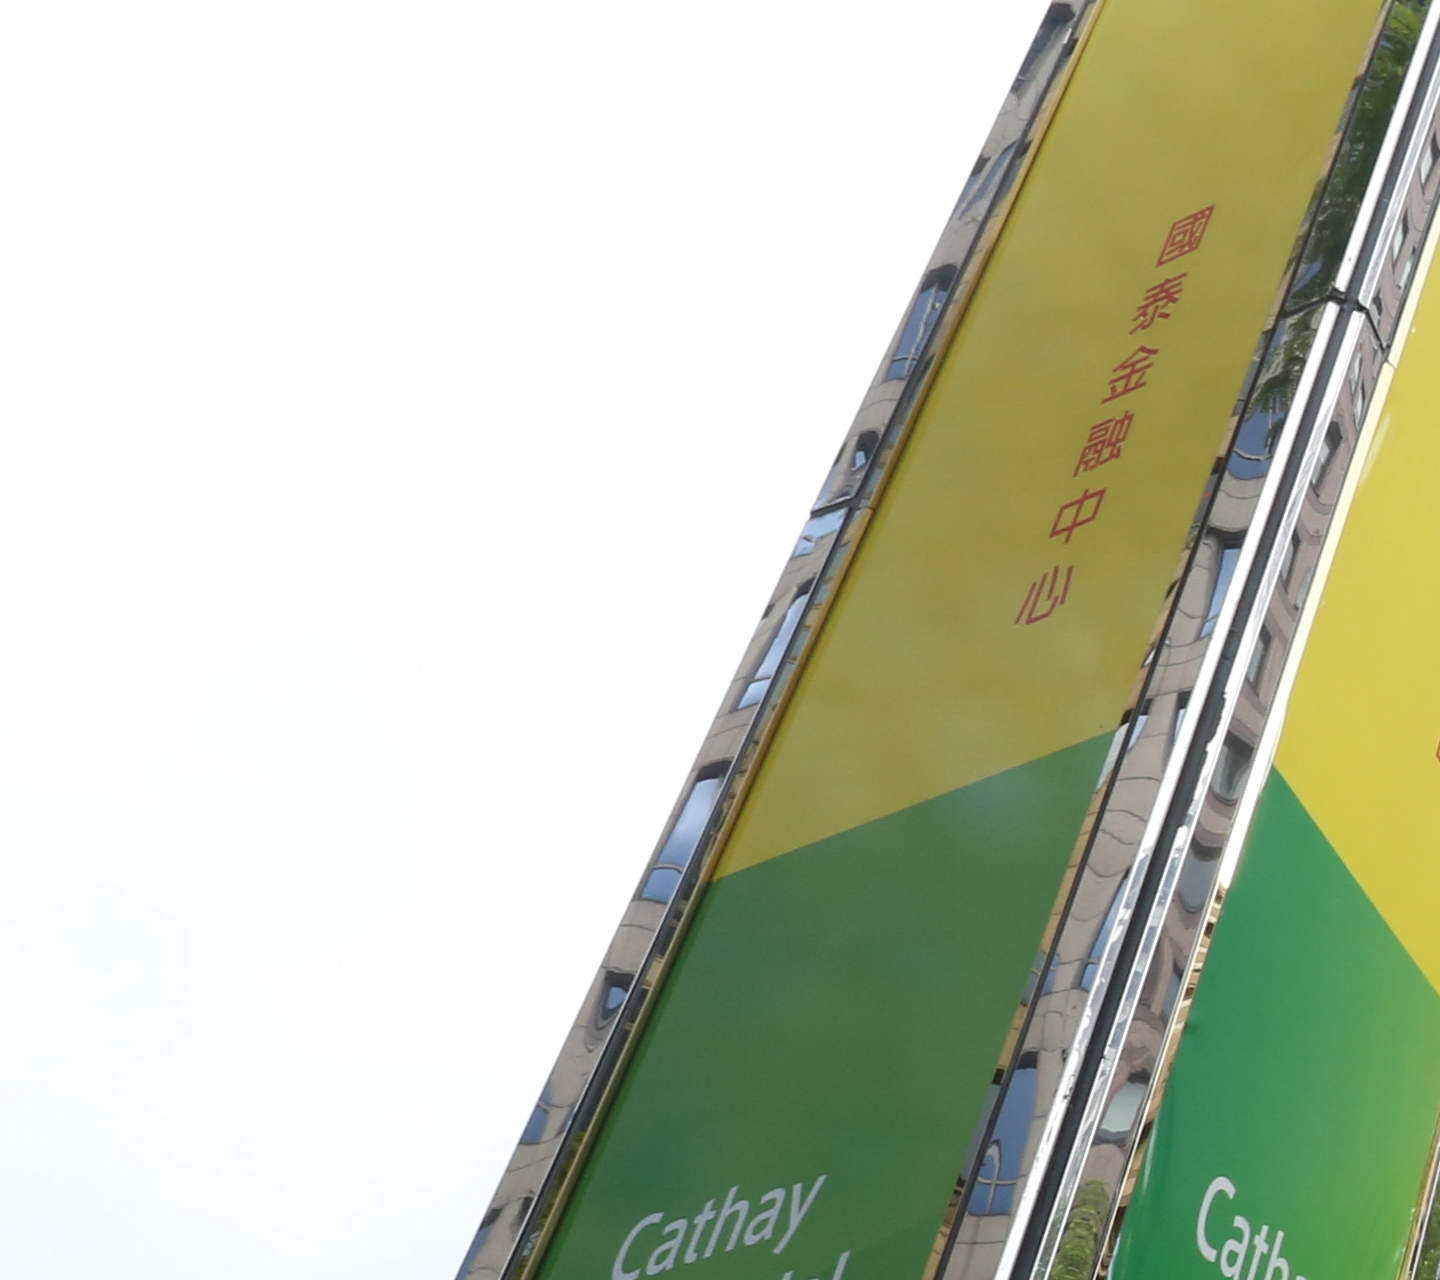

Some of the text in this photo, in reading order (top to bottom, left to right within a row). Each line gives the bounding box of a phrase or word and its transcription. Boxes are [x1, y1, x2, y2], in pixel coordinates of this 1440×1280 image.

[1013, 204, 1215, 626] 國泰金融中心
